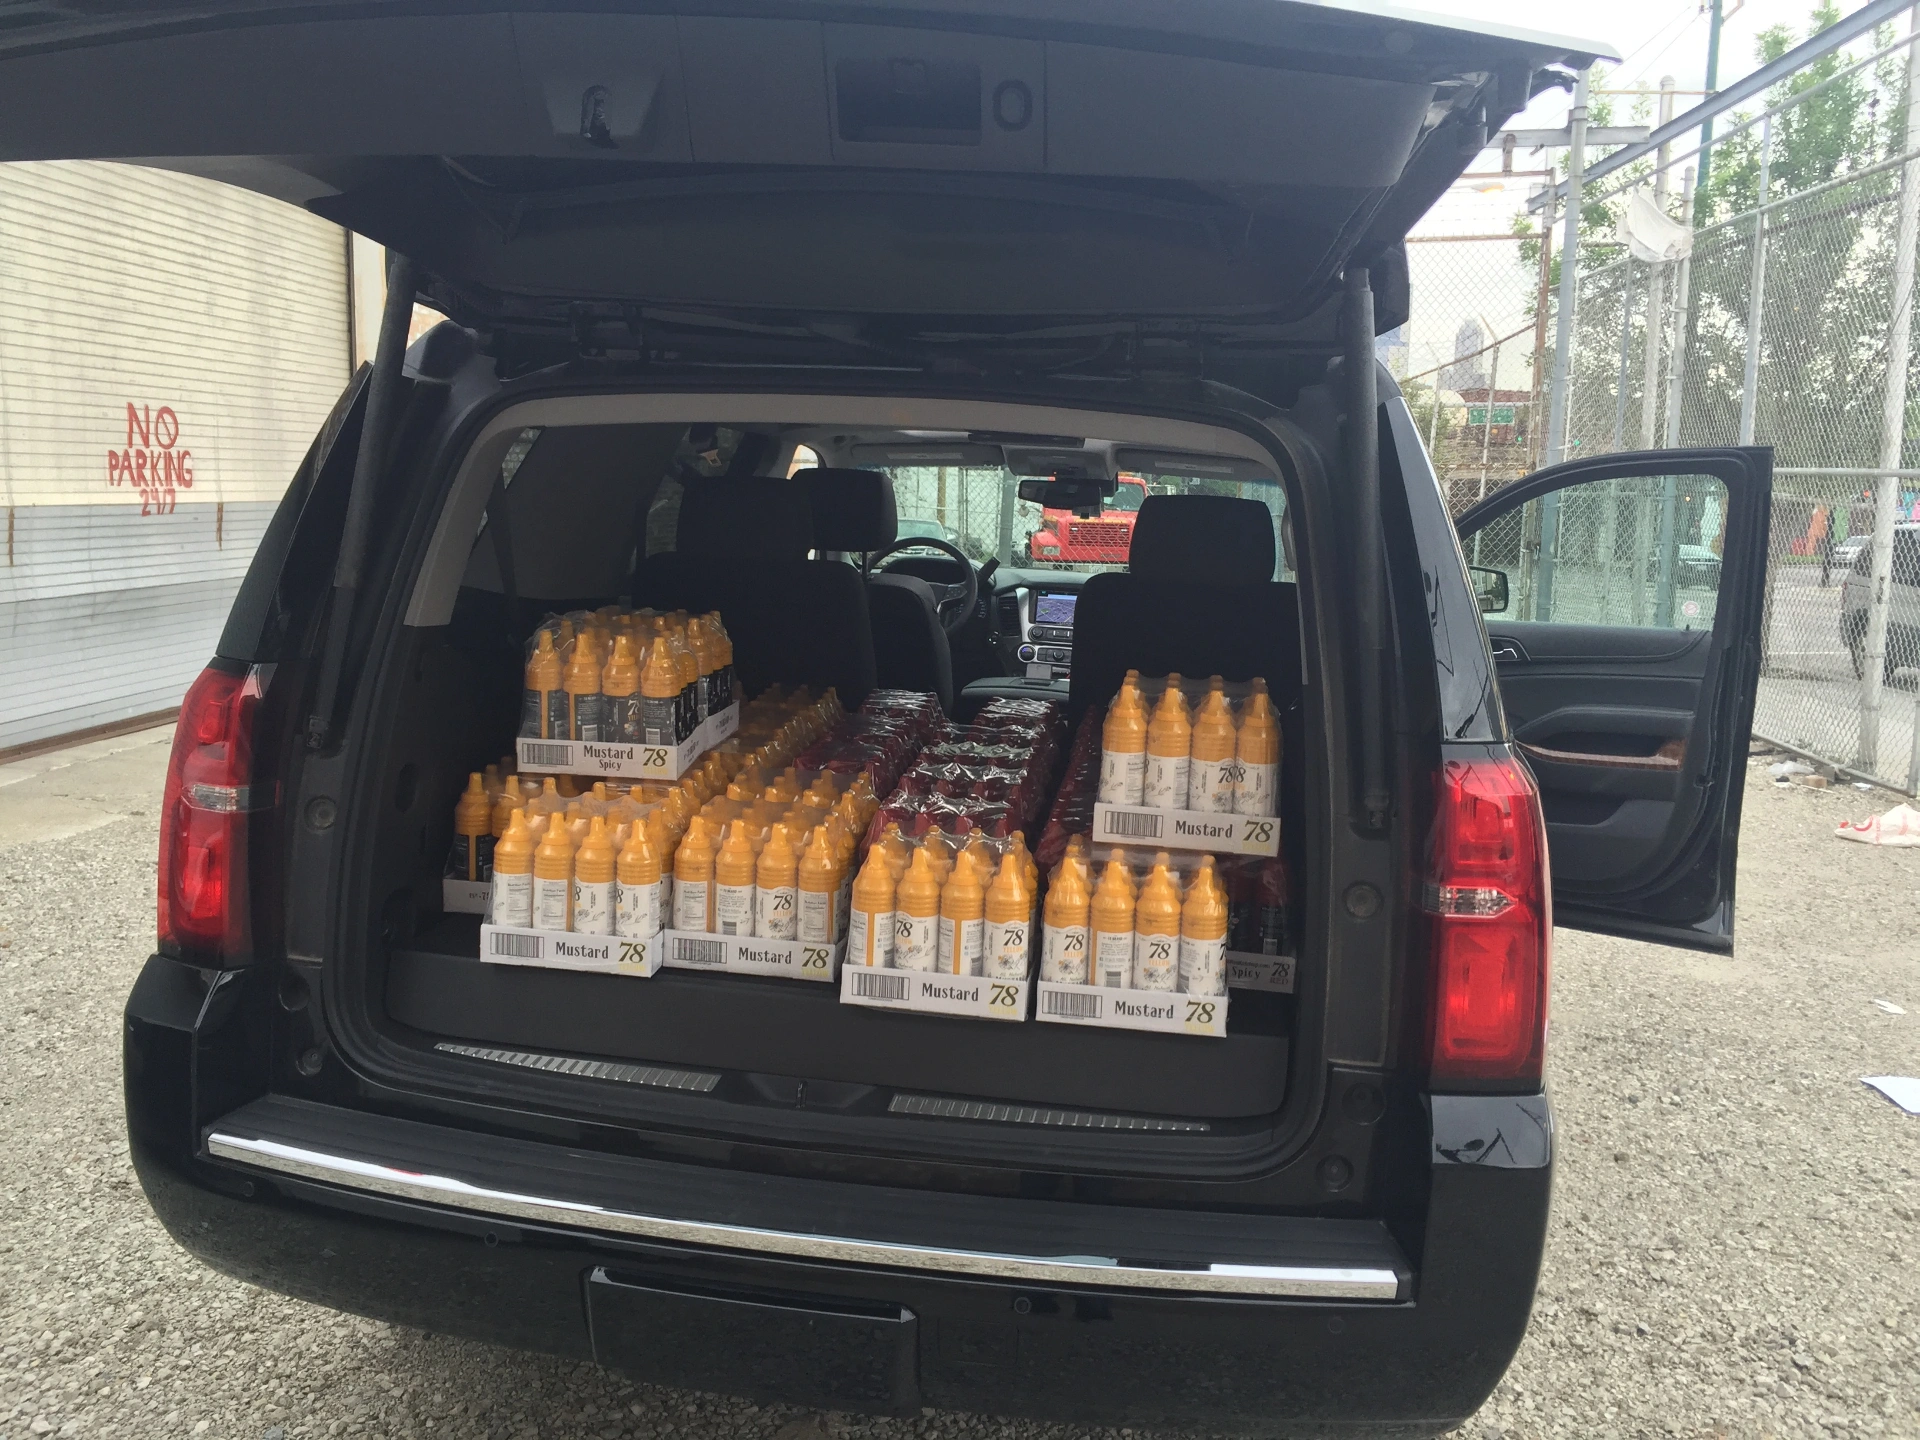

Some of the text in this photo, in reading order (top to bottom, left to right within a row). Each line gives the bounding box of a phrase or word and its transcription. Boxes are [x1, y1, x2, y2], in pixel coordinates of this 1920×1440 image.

[127, 401, 179, 450] NO
[108, 449, 193, 488] PARKING
[139, 488, 176, 517] 24/7
[583, 744, 634, 760] Mustard
[642, 747, 668, 767] 78
[598, 759, 622, 772] Spicy
[1174, 819, 1233, 839] Mustard
[1243, 819, 1274, 843] 78
[773, 894, 793, 911] 78
[896, 919, 913, 938] 78
[1003, 929, 1024, 947] 78
[555, 941, 609, 960] Mustard
[1064, 933, 1085, 951] 78
[1149, 942, 1171, 960] 78
[618, 941, 647, 964] 78
[738, 946, 792, 965] Mustard
[801, 946, 830, 969] 78
[1232, 965, 1260, 979] Spicy
[1271, 961, 1290, 978] 78
[922, 982, 979, 1002] Mustard
[989, 983, 1019, 1007] 78
[1114, 1000, 1174, 1019] Mustard
[1185, 1000, 1216, 1024] 78
